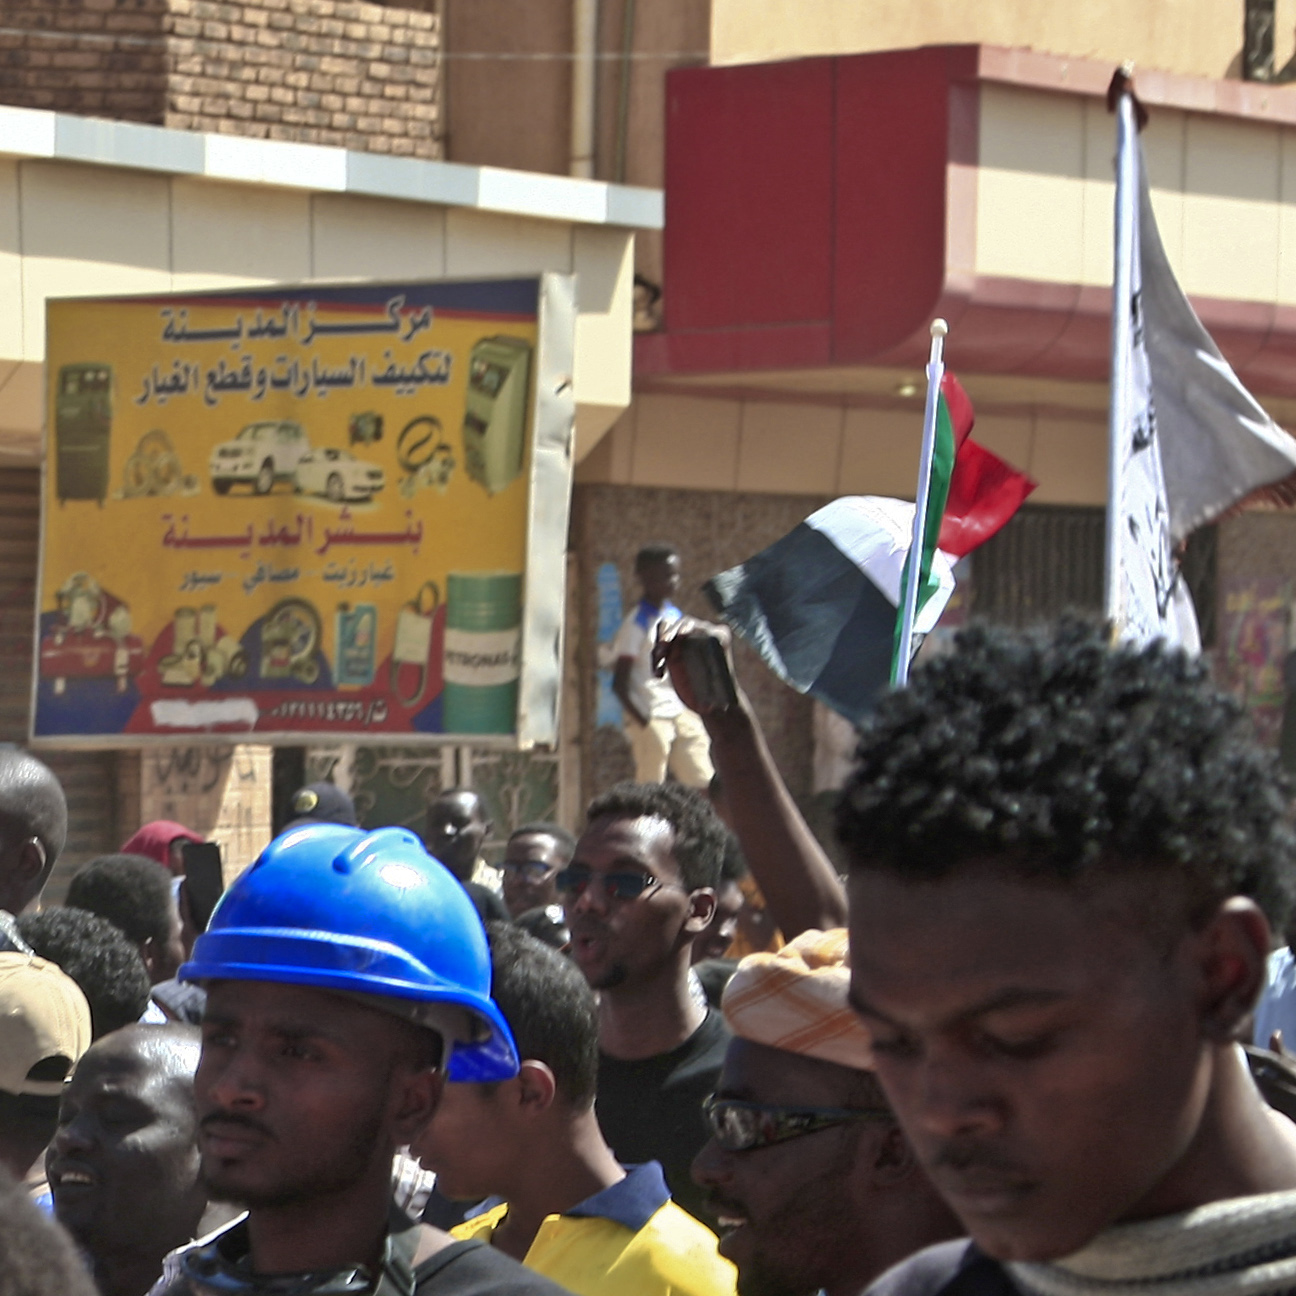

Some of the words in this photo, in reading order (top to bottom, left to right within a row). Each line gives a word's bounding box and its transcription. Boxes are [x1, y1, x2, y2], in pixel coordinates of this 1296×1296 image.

[161, 300, 298, 350] المدينة
[300, 294, 433, 346] مركز
[134, 357, 199, 406] الغيار
[270, 355, 365, 398] السيارات
[371, 350, 452, 396] لتكييف
[161, 511, 313, 561] المدينة
